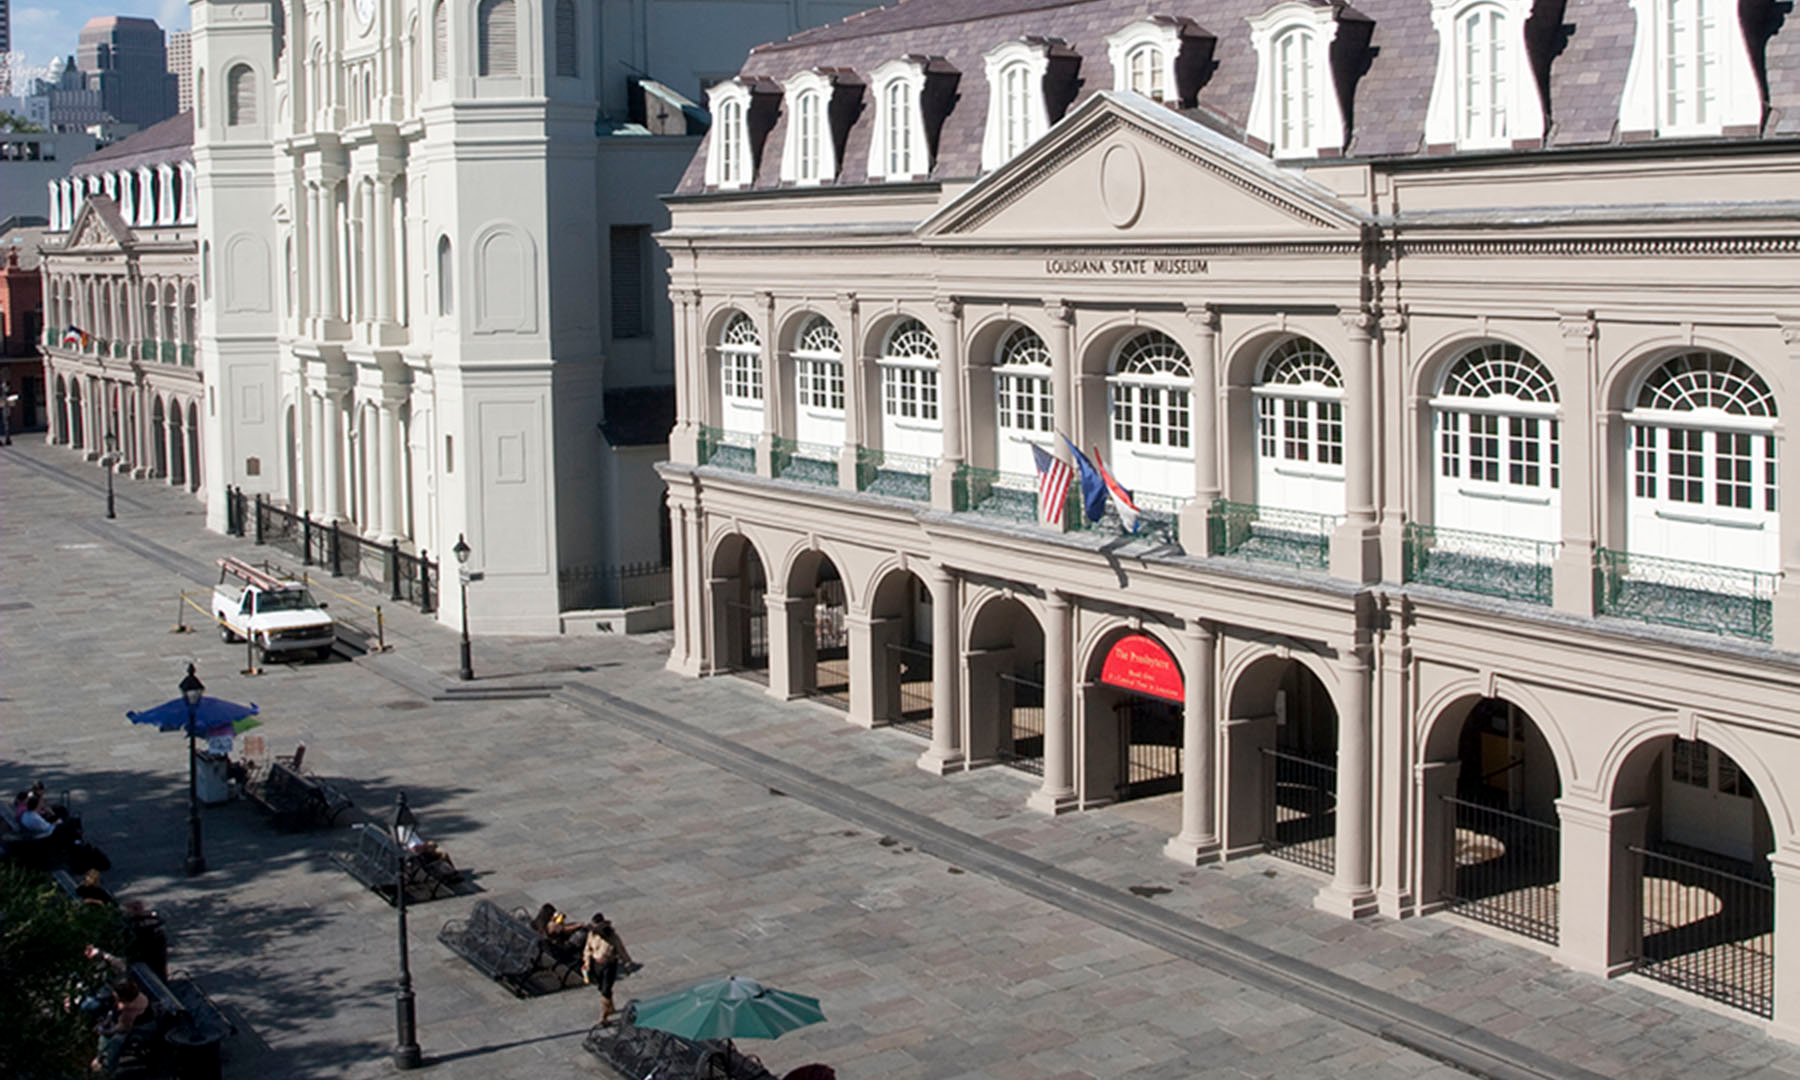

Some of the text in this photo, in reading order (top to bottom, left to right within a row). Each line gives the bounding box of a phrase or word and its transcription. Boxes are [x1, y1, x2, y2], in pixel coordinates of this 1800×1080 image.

[1045, 259, 1209, 274] LOUISIANA STATE MUSEUM
